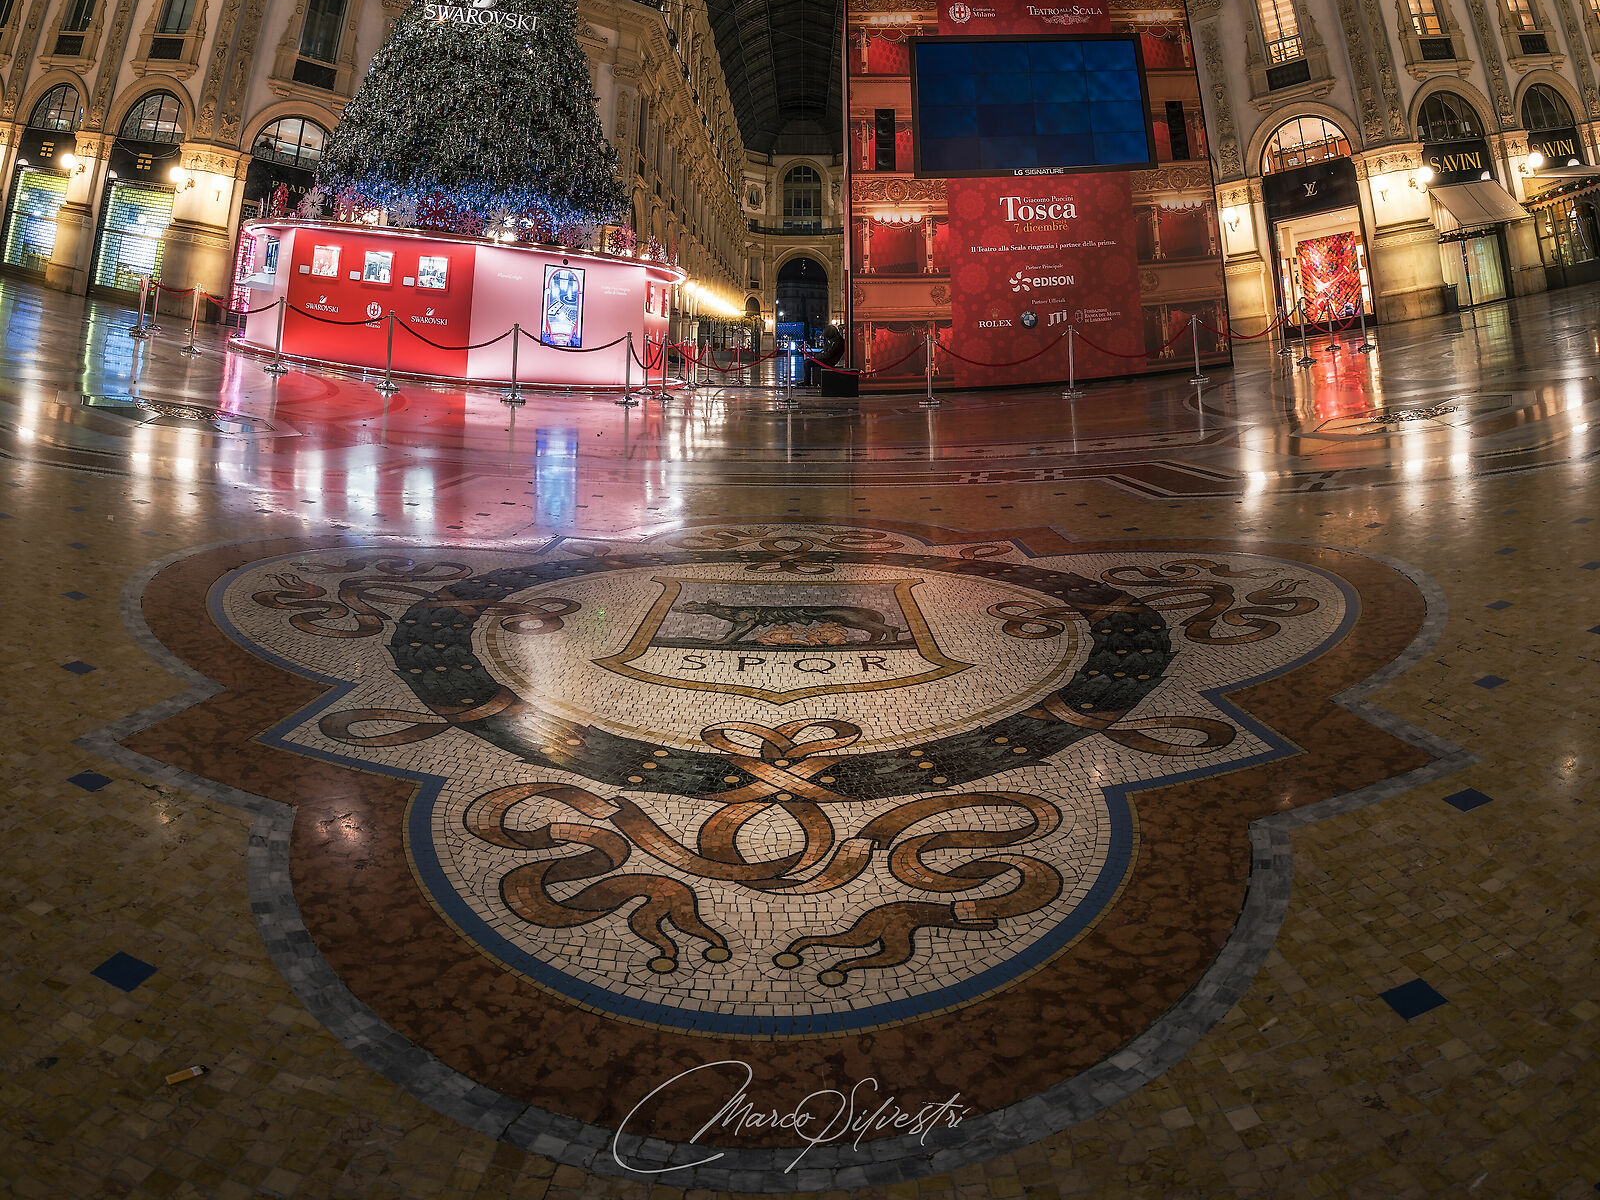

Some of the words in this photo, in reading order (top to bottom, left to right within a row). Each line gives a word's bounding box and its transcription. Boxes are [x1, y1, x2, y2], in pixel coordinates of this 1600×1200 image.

[1026, 5, 1060, 16] TEATRO
[1073, 5, 1103, 15] SCALA
[424, 3, 538, 32] SWAROVSKI
[1531, 138, 1576, 158] SAVINI
[1429, 151, 1483, 174] SAVINI
[1024, 167, 1064, 176] SIGNATURE
[1023, 196, 1050, 204] Giacomo
[1051, 194, 1074, 202] Puccini
[999, 196, 1078, 222] Tosca
[1013, 223, 1020, 233] 7
[1023, 222, 1068, 233] dicembre
[1027, 243, 1055, 252] ringrazia
[1059, 241, 1081, 250] partner
[305, 302, 340, 313] SWAROVSKI
[410, 315, 449, 326] SWAROVSKI
[978, 319, 1013, 329] ROLEX
